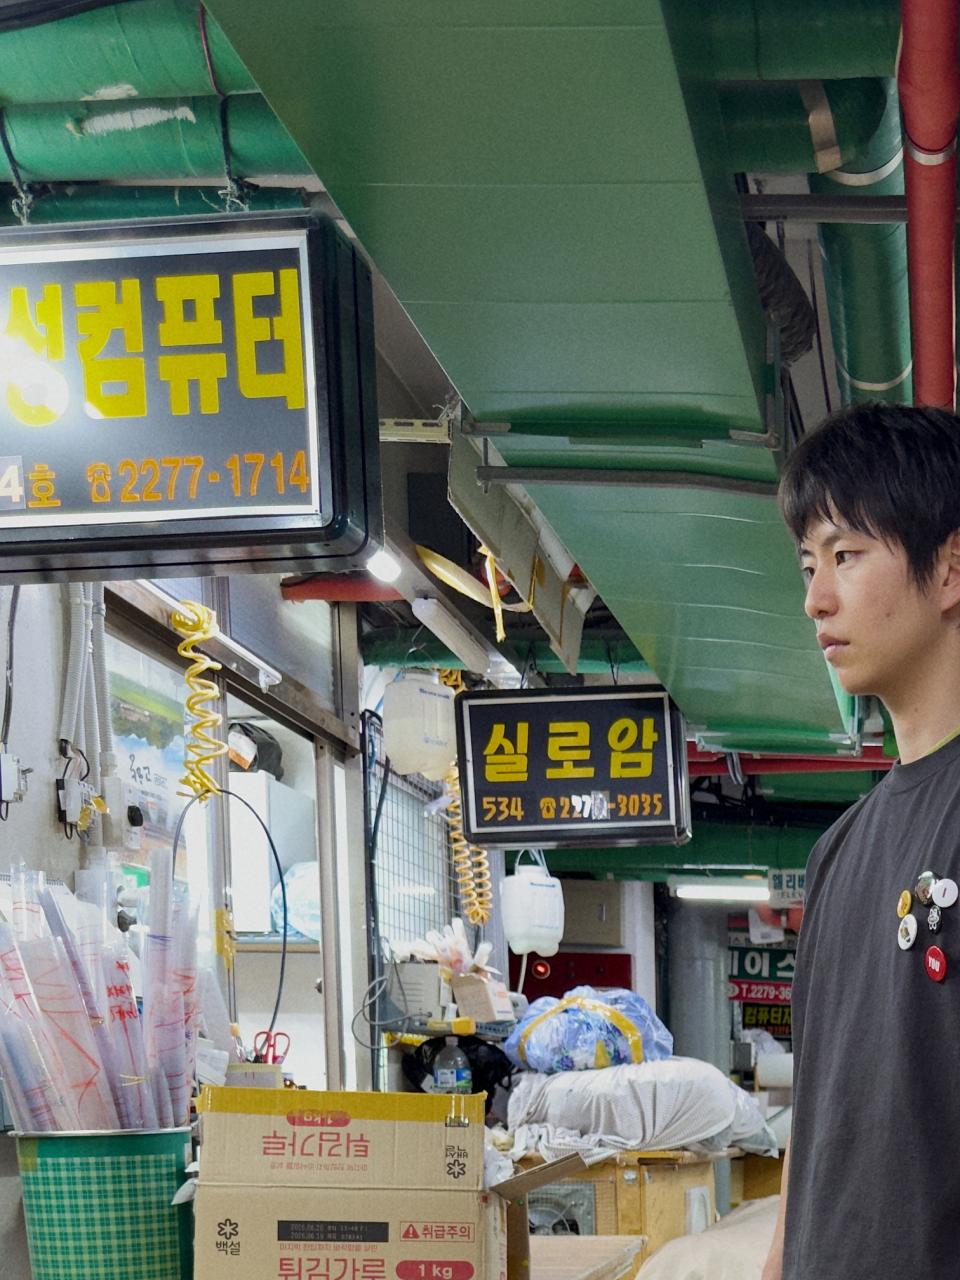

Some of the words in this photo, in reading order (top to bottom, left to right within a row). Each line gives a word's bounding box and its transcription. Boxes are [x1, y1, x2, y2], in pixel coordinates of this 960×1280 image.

[120, 450, 310, 503] 2277-1714
[483, 717, 659, 783] 실로암
[482, 795, 525, 822] 534
[559, 791, 664, 820] 227-3035
[262, 1130, 371, 1158] 튀김가루
[422, 1224, 471, 1240] 취급주의
[215, 1240, 241, 1256] 백설
[418, 1263, 426, 1278] 1
[432, 1263, 453, 1280] kg
